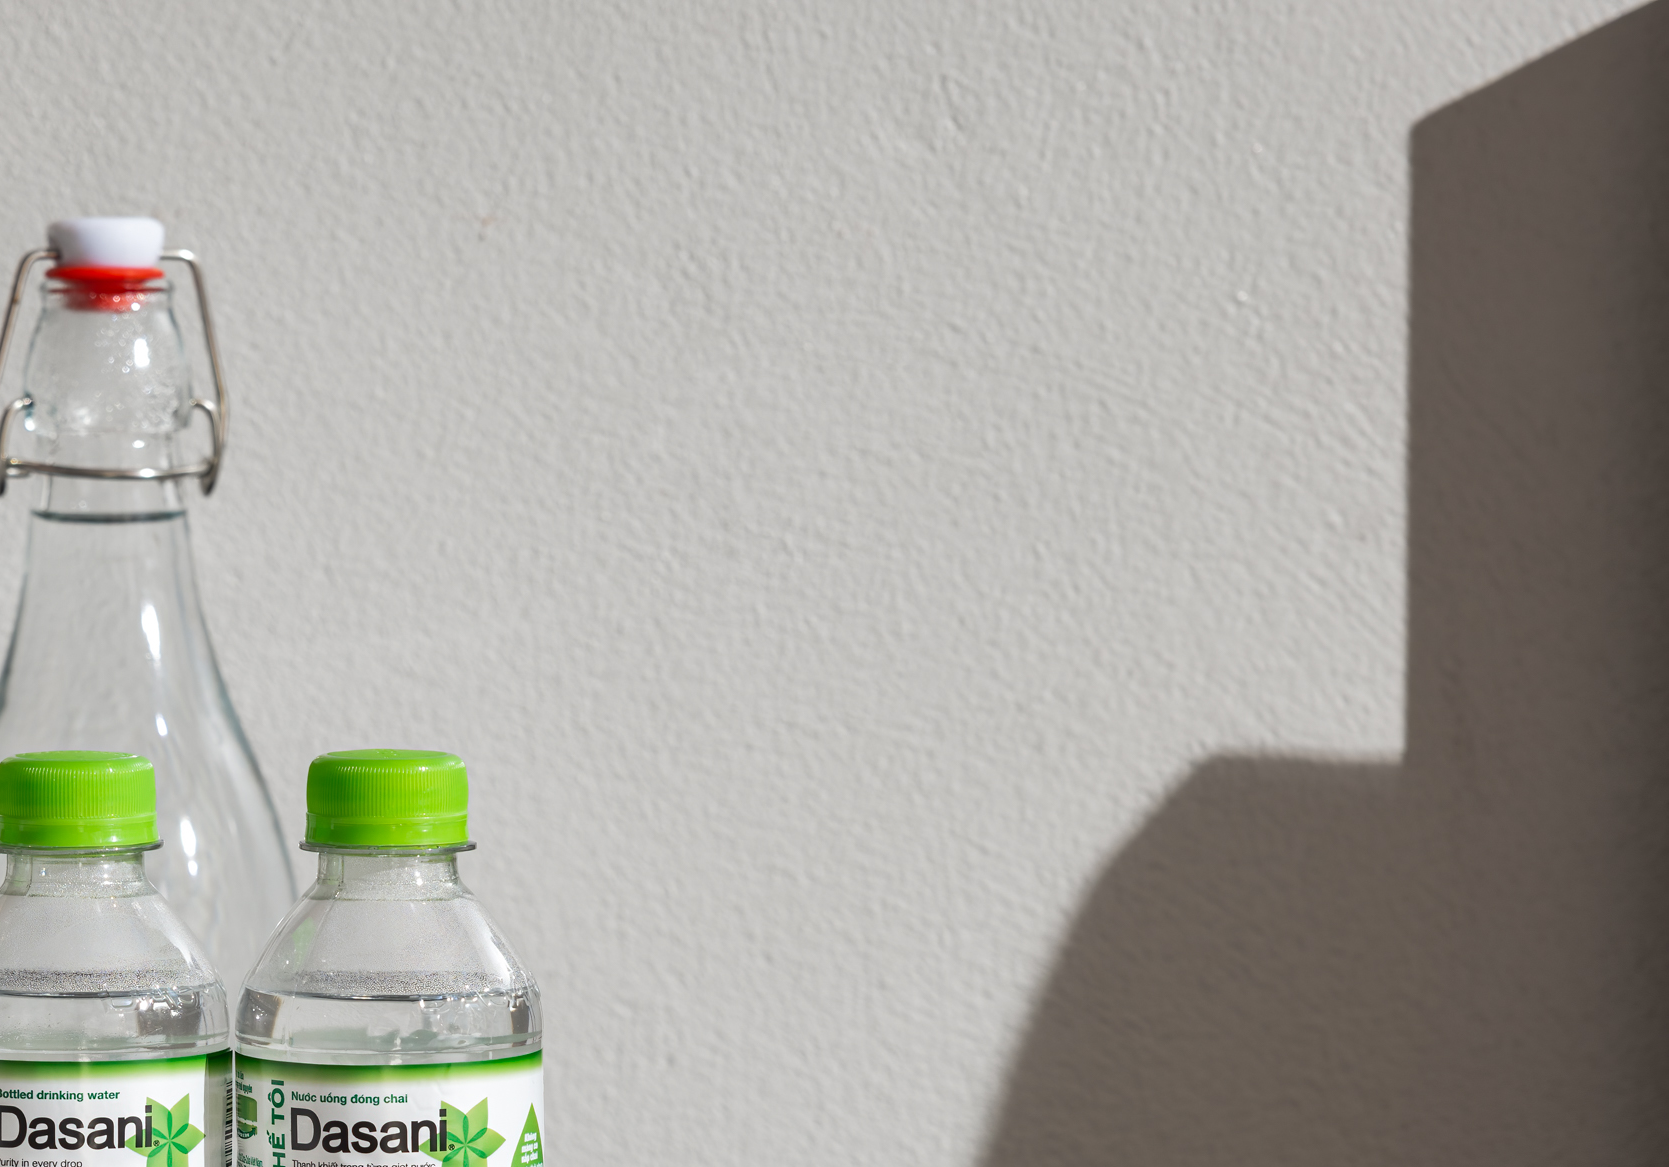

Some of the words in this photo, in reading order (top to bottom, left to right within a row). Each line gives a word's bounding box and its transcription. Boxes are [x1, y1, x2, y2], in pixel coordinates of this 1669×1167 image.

[36, 1089, 84, 1102] drinking
[87, 1090, 121, 1100] water
[267, 1079, 286, 1126] TÔI
[291, 1090, 318, 1103] Nước
[320, 1091, 347, 1106] uống
[350, 1092, 380, 1106] đóng
[383, 1093, 409, 1104] chai
[21, 1157, 30, 1167] in
